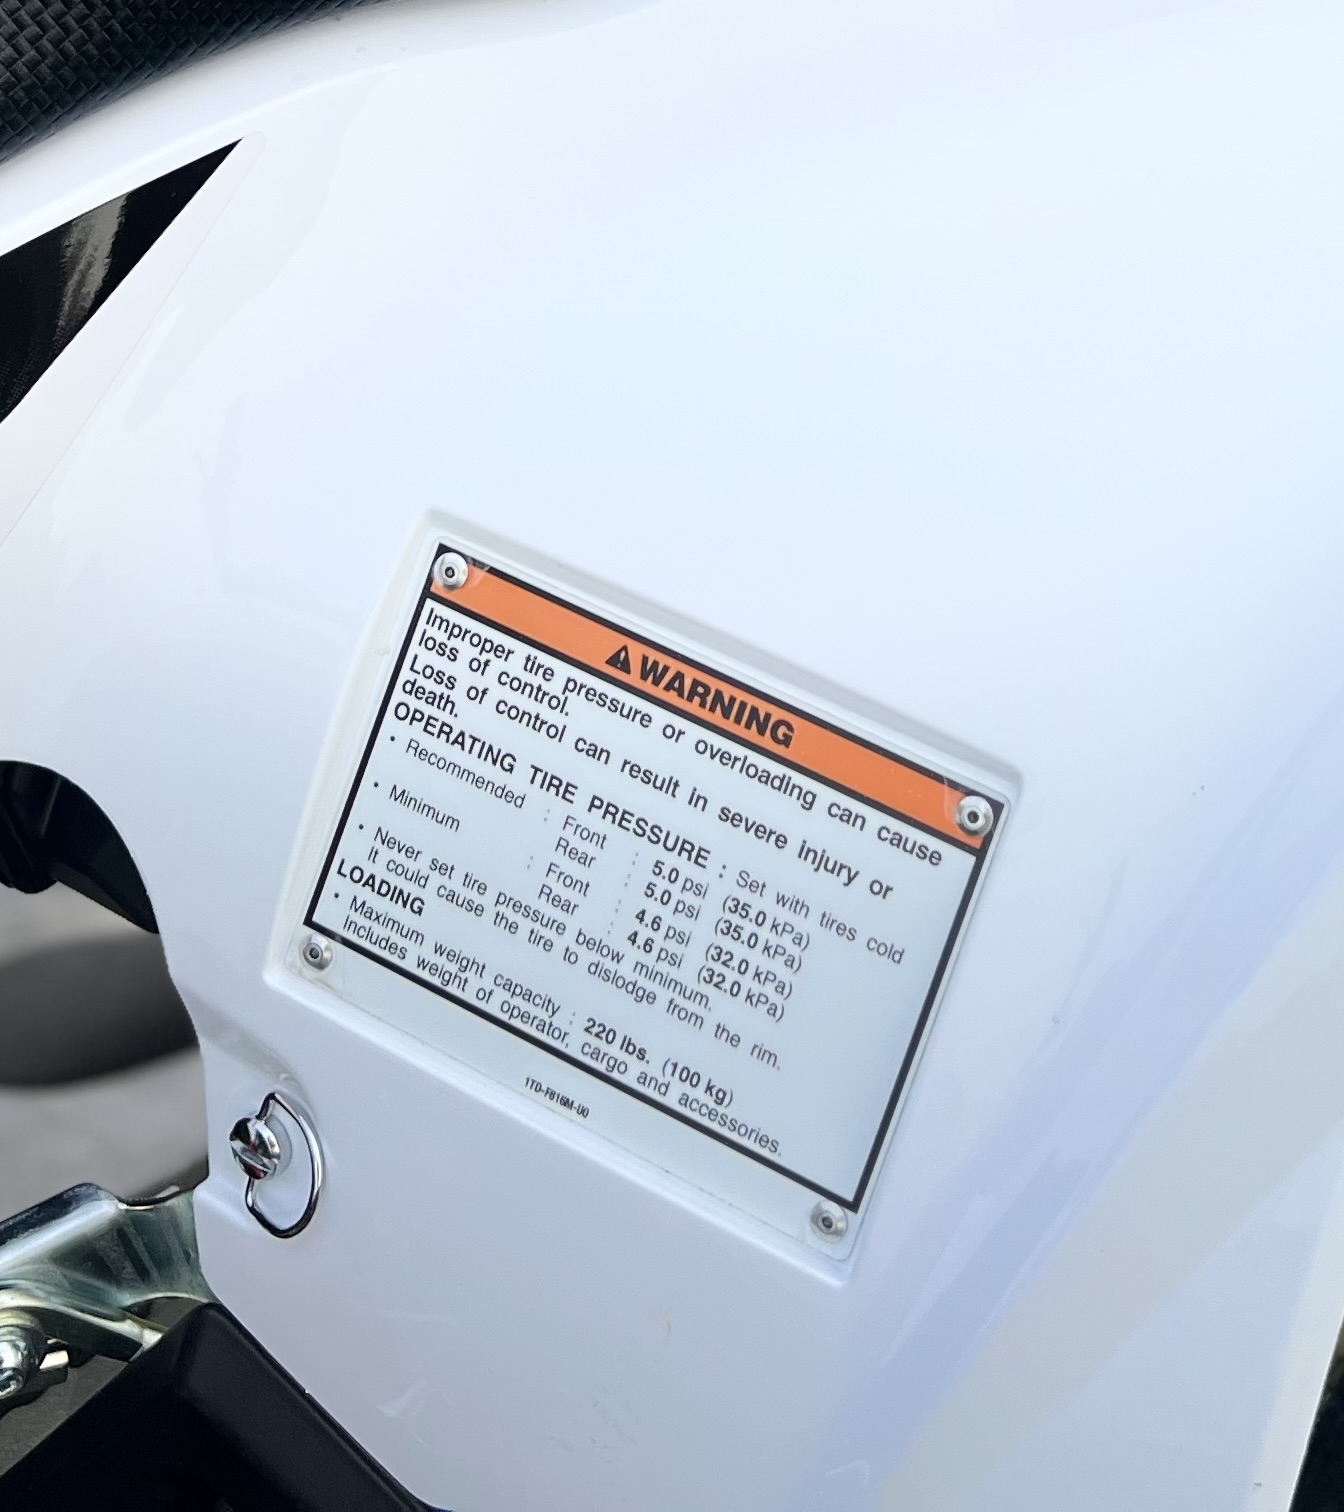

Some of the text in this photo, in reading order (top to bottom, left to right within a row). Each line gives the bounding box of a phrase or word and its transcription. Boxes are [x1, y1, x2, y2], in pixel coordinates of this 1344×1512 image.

[401, 677, 458, 719] death.
[408, 653, 894, 900] Loss of control can result in severe injury or
[418, 628, 569, 717] loss of control.
[425, 607, 943, 867] Improper tire pressure or overloading can cause
[639, 653, 795, 749] WARNING
[336, 857, 426, 917] LOADING
[373, 826, 712, 1012] Never set tire pressure below minimum.
[388, 783, 461, 833] Minimum
[545, 861, 590, 898] Front
[634, 908, 663, 933] 4.6
[663, 924, 693, 949] psi
[705, 942, 750, 977] (32.0
[751, 964, 793, 1001] kPa)
[393, 700, 517, 775] OPERATING
[529, 763, 579, 805] TIRE
[587, 794, 711, 870] PRESSURE
[735, 869, 767, 898] Set
[775, 891, 810, 920] with
[819, 910, 857, 942] tires
[866, 937, 905, 965] cold
[405, 737, 527, 809] Recommended
[562, 814, 608, 850] Front
[651, 859, 680, 885] 5.0
[680, 876, 710, 900] psi
[722, 894, 767, 929] (35.0
[769, 916, 810, 953] kPa)
[554, 836, 597, 869] Rear
[643, 880, 672, 907] 5.0
[672, 898, 702, 922] psi
[714, 916, 759, 950] (35.0
[761, 938, 802, 975] kPa)
[342, 913, 782, 1157] Includes weight of operator, cargo and accessories.
[348, 894, 425, 947] Maximum
[433, 940, 486, 980] weight
[493, 973, 561, 1019] capacity
[583, 1017, 617, 1046] 220
[619, 1034, 650, 1065] lbs.
[661, 1057, 701, 1089] (100
[703, 1077, 734, 1109] kg)
[367, 845, 780, 1071] It could cause the tire to dislodge from the rim.
[537, 883, 580, 917] Rear
[626, 930, 655, 955] 4.6
[655, 946, 685, 971] psi
[697, 964, 742, 999] (32.0
[744, 986, 785, 1024] kPa)
